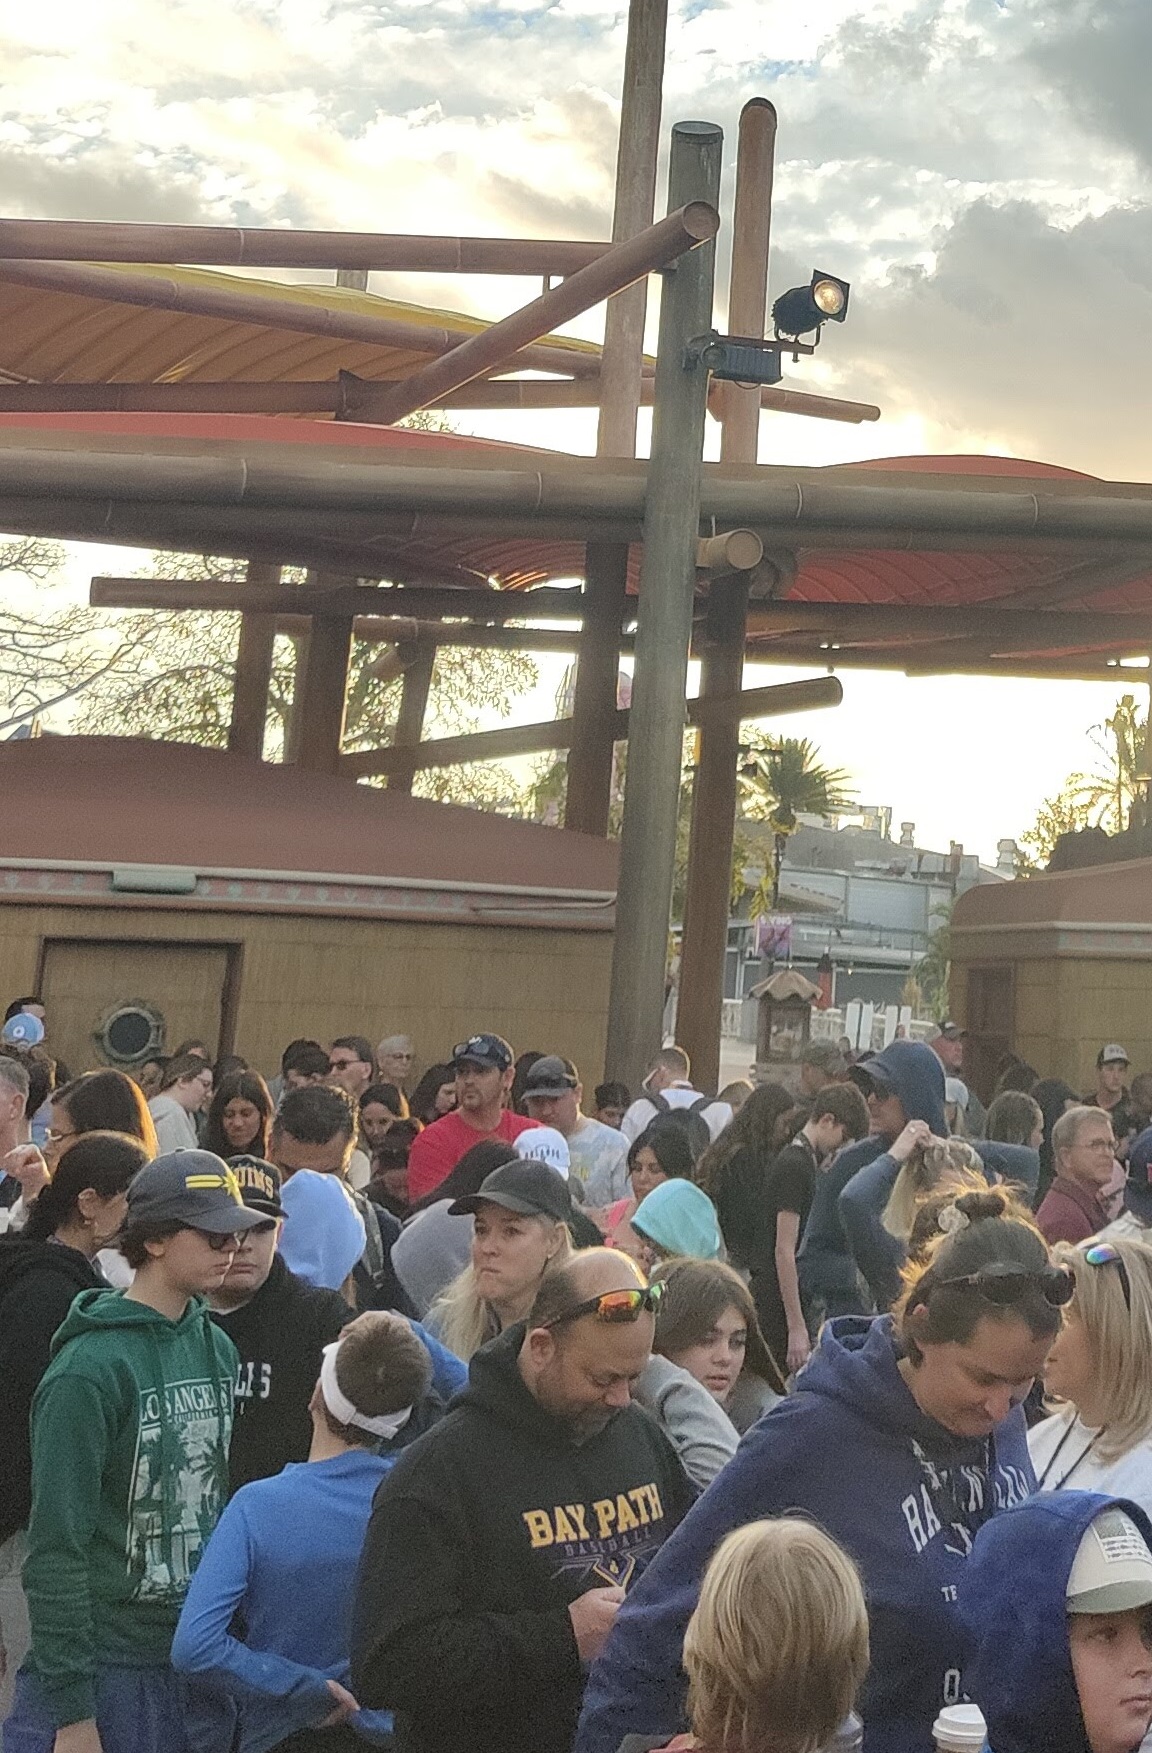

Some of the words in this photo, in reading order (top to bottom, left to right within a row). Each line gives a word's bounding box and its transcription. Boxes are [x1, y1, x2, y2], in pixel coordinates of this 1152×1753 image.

[234, 1165, 274, 1199] UINS
[174, 1383, 229, 1412] ANGELS
[522, 1503, 590, 1548] BAY
[592, 1482, 664, 1539] PATH
[941, 1584, 958, 1602] TE
